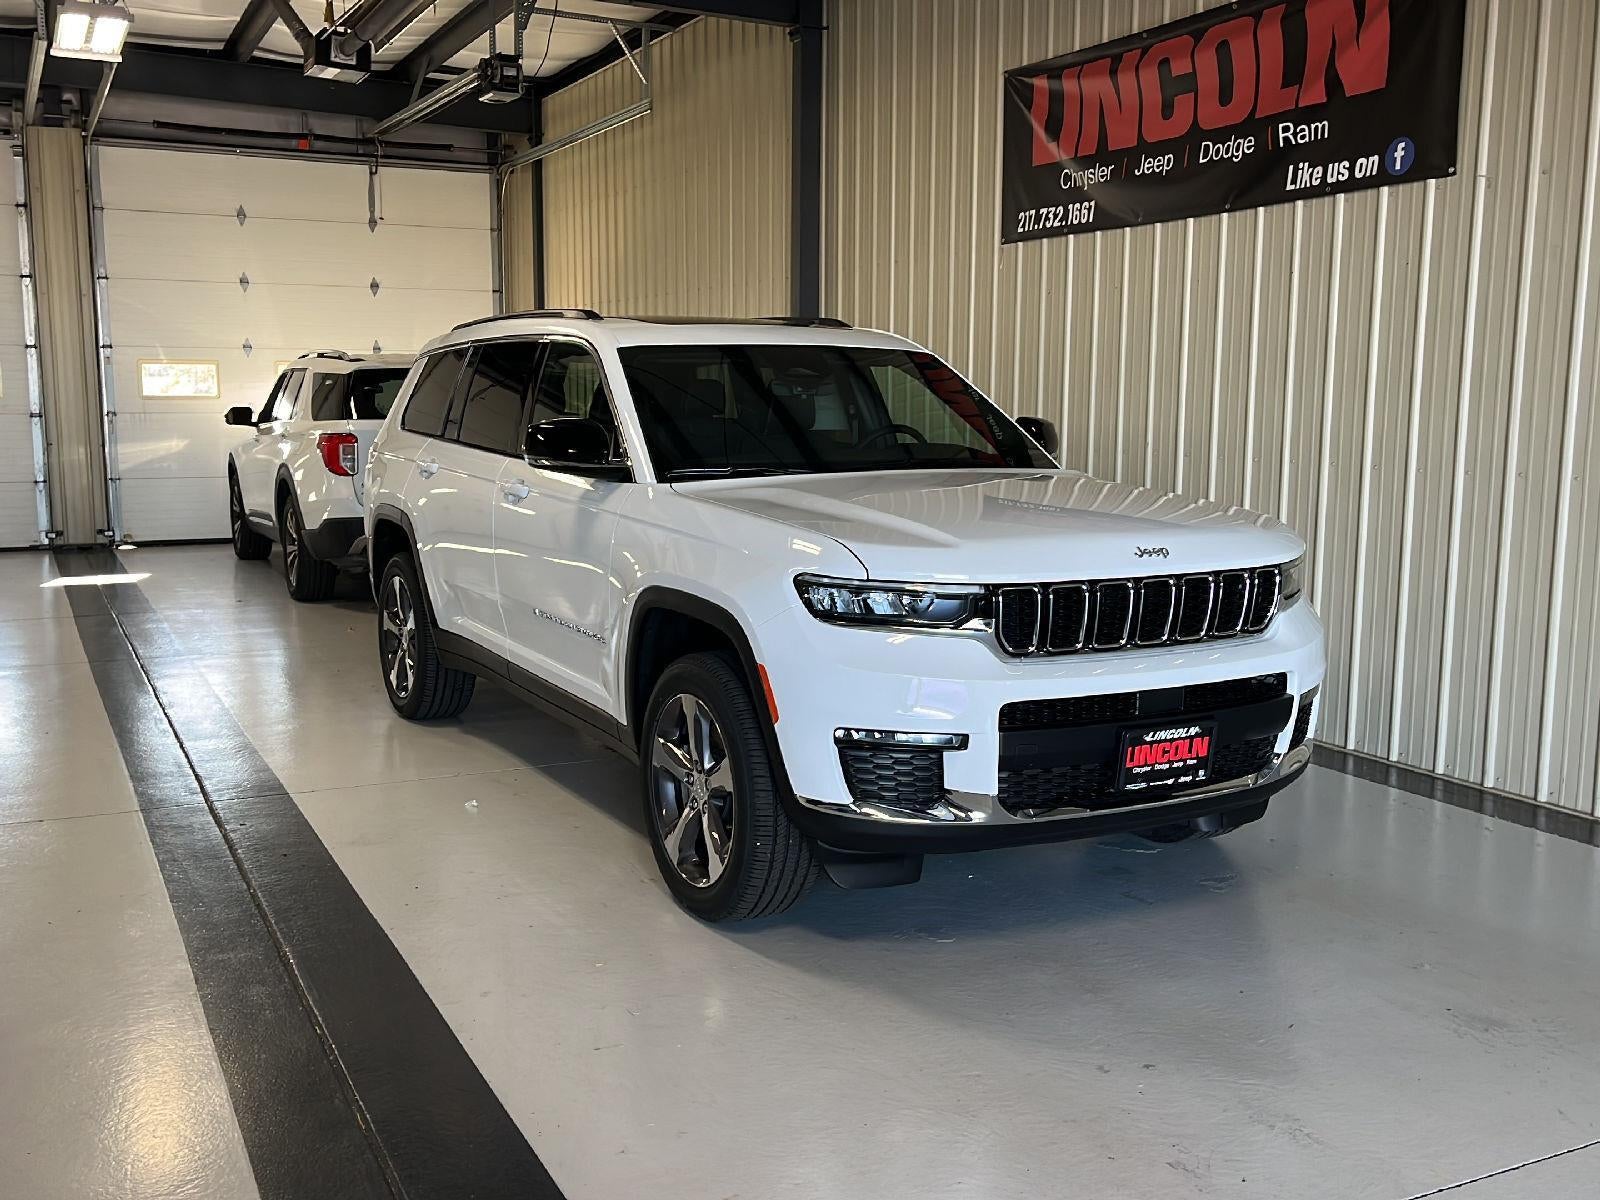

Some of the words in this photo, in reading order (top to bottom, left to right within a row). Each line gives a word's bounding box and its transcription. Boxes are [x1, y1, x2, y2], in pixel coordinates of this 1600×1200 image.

[1032, 0, 1391, 166] LINCOLN
[1060, 163, 1114, 190] Chrysler
[1135, 153, 1174, 176] Jeep
[1199, 135, 1255, 163] Dodge
[1278, 120, 1329, 147] Ram
[1286, 162, 1322, 190] Like
[1326, 160, 1349, 184] us
[1355, 154, 1379, 179] on
[1017, 200, 1096, 233] 217.732.1661
[1134, 546, 1170, 559] Jeep
[1146, 726, 1200, 741] LINCOLN
[1125, 736, 1210, 768] LINCOLN
